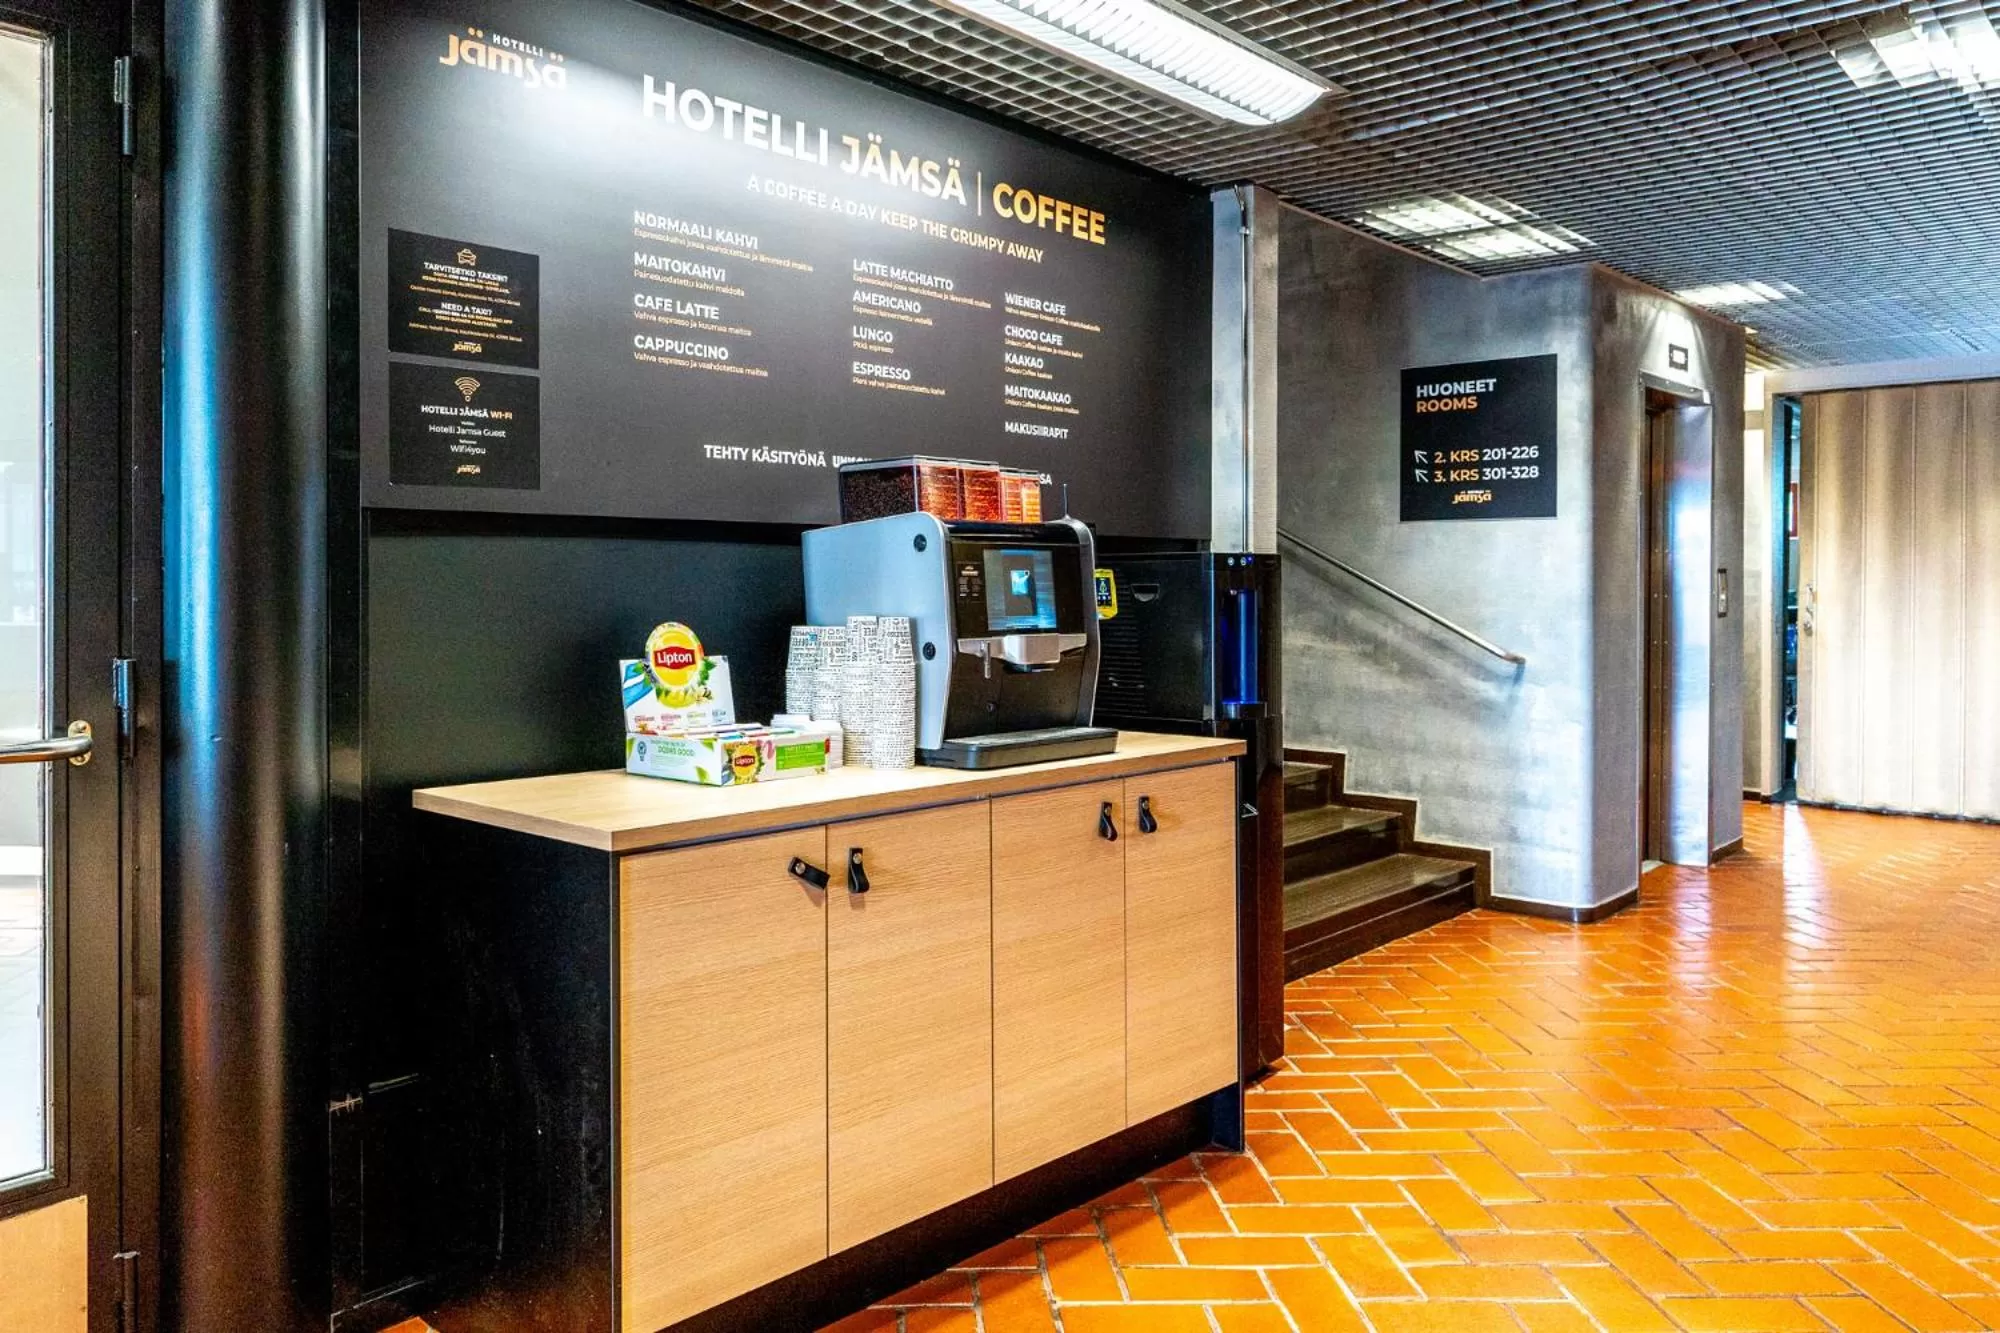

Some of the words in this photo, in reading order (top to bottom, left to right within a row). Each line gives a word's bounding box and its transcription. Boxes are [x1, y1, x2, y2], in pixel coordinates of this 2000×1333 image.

[493, 33, 543, 57] HOTELLI
[643, 75, 829, 166] HOTELLI
[840, 132, 966, 205] JÄMSÄ
[993, 182, 1106, 245] COFFEE
[747, 173, 760, 192] A
[764, 178, 826, 206] COFFEE
[831, 195, 842, 213] A
[846, 198, 877, 220] DAY
[880, 210, 919, 232] KEEP
[922, 219, 948, 240] THE
[951, 226, 1005, 254] GRUMPY
[1006, 240, 1044, 263] AWAY
[634, 211, 713, 240] NORMAALI
[715, 229, 759, 249] KAHVI
[634, 252, 726, 282] MAITOKAHVI
[853, 258, 888, 277] LATTE
[440, 302, 463, 312] NEED
[464, 305, 471, 313] A
[634, 293, 673, 313] CAFE
[676, 301, 720, 320] LATTE
[852, 290, 922, 313] AMERICANO
[1005, 292, 1041, 311] WIENER
[1043, 301, 1067, 316] CAFE
[853, 325, 893, 343] LUNGO
[1004, 325, 1038, 340] CHOCO
[1040, 331, 1063, 346] CAFE
[634, 335, 729, 361] CAPPUCCINO
[853, 361, 911, 381] ESPRESSO
[1416, 378, 1497, 398] HUONEET
[421, 405, 458, 416] HOTELLI
[459, 406, 489, 419] JÄMSÄ
[490, 411, 513, 420] WI-FI
[1416, 396, 1478, 413] ROOMS
[429, 425, 456, 434] Hotelli
[483, 429, 506, 438] Guest
[703, 444, 749, 462] TEHTY
[752, 447, 827, 468] KÄSITYÖNÄ
[1434, 451, 1447, 464] 2.
[1450, 449, 1480, 463] KRS
[1482, 445, 1540, 461] 201-226
[1434, 470, 1447, 483] 3.
[1450, 468, 1480, 482] KRS
[1482, 466, 1540, 480] 301-328
[657, 651, 692, 666] Lipton
